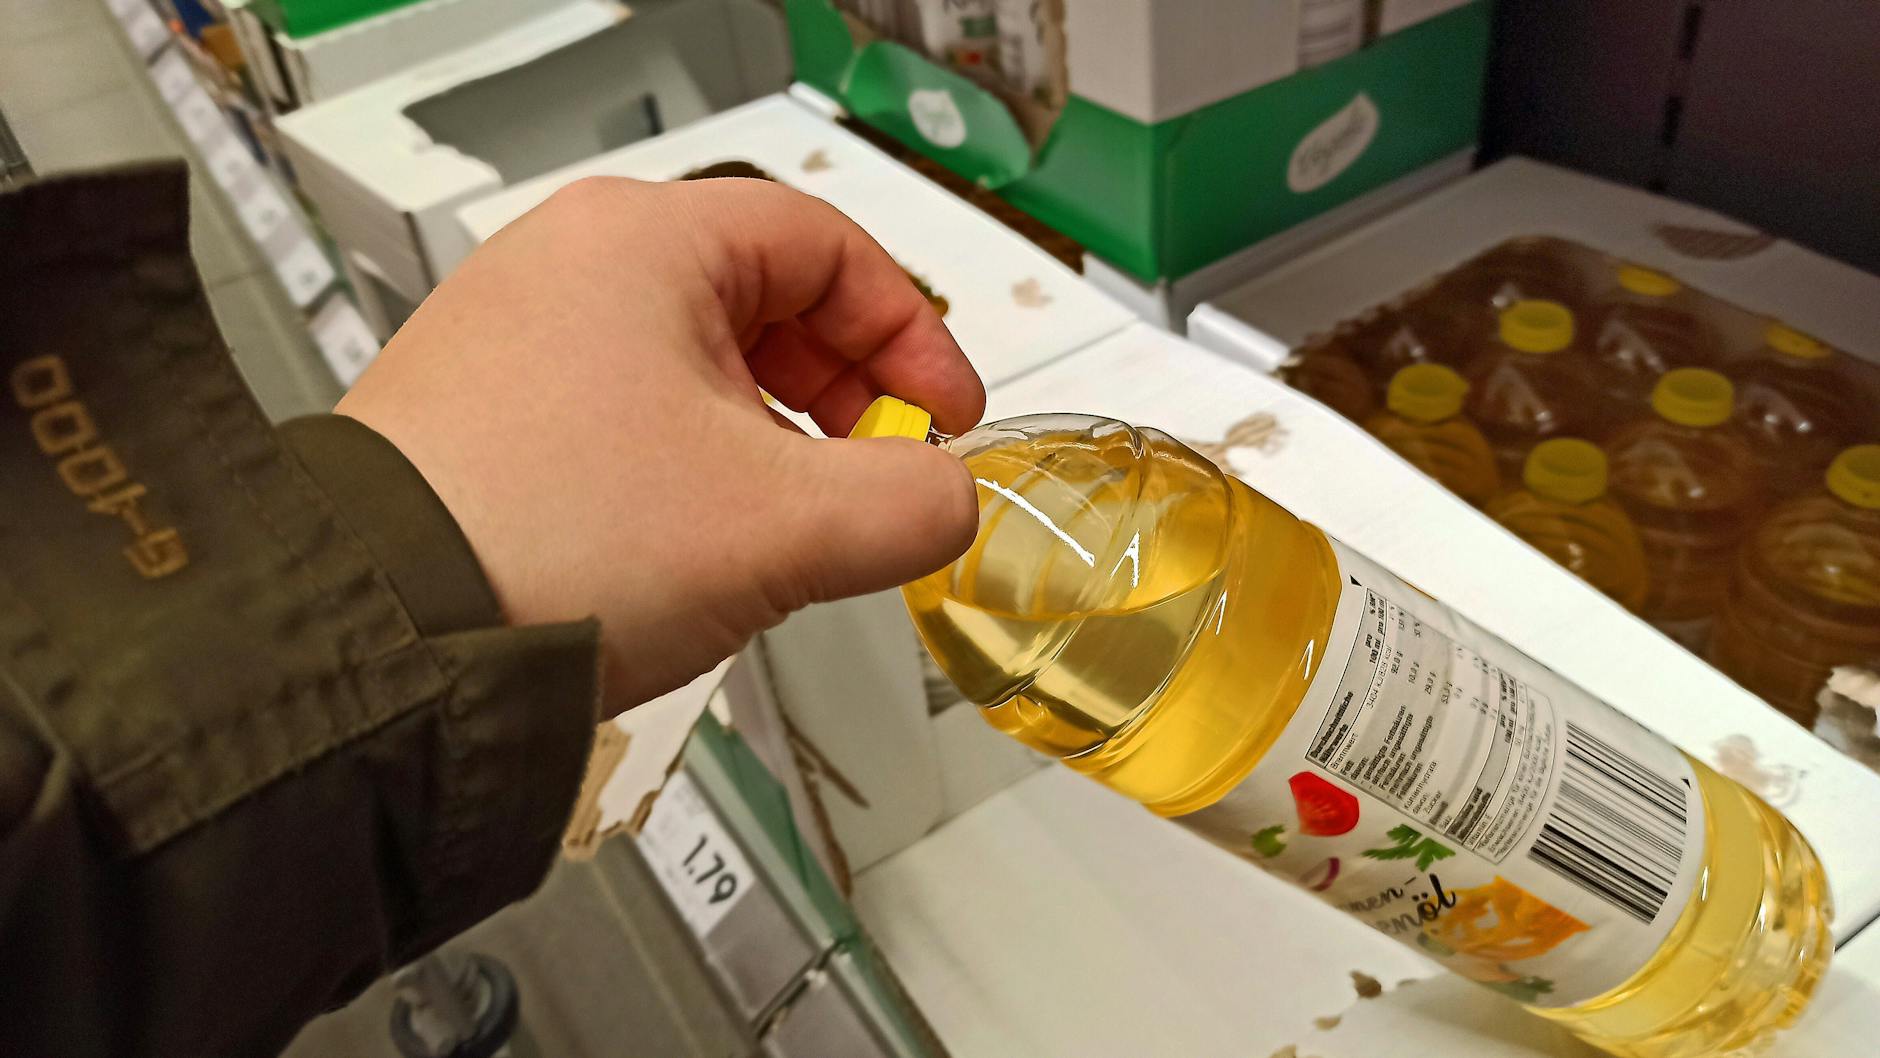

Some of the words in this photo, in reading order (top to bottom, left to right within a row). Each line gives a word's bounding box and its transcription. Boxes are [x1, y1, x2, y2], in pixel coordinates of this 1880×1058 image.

[12, 355, 188, 577] G-1000
[1368, 648, 1378, 664] 100
[683, 834, 737, 905] 1.79
